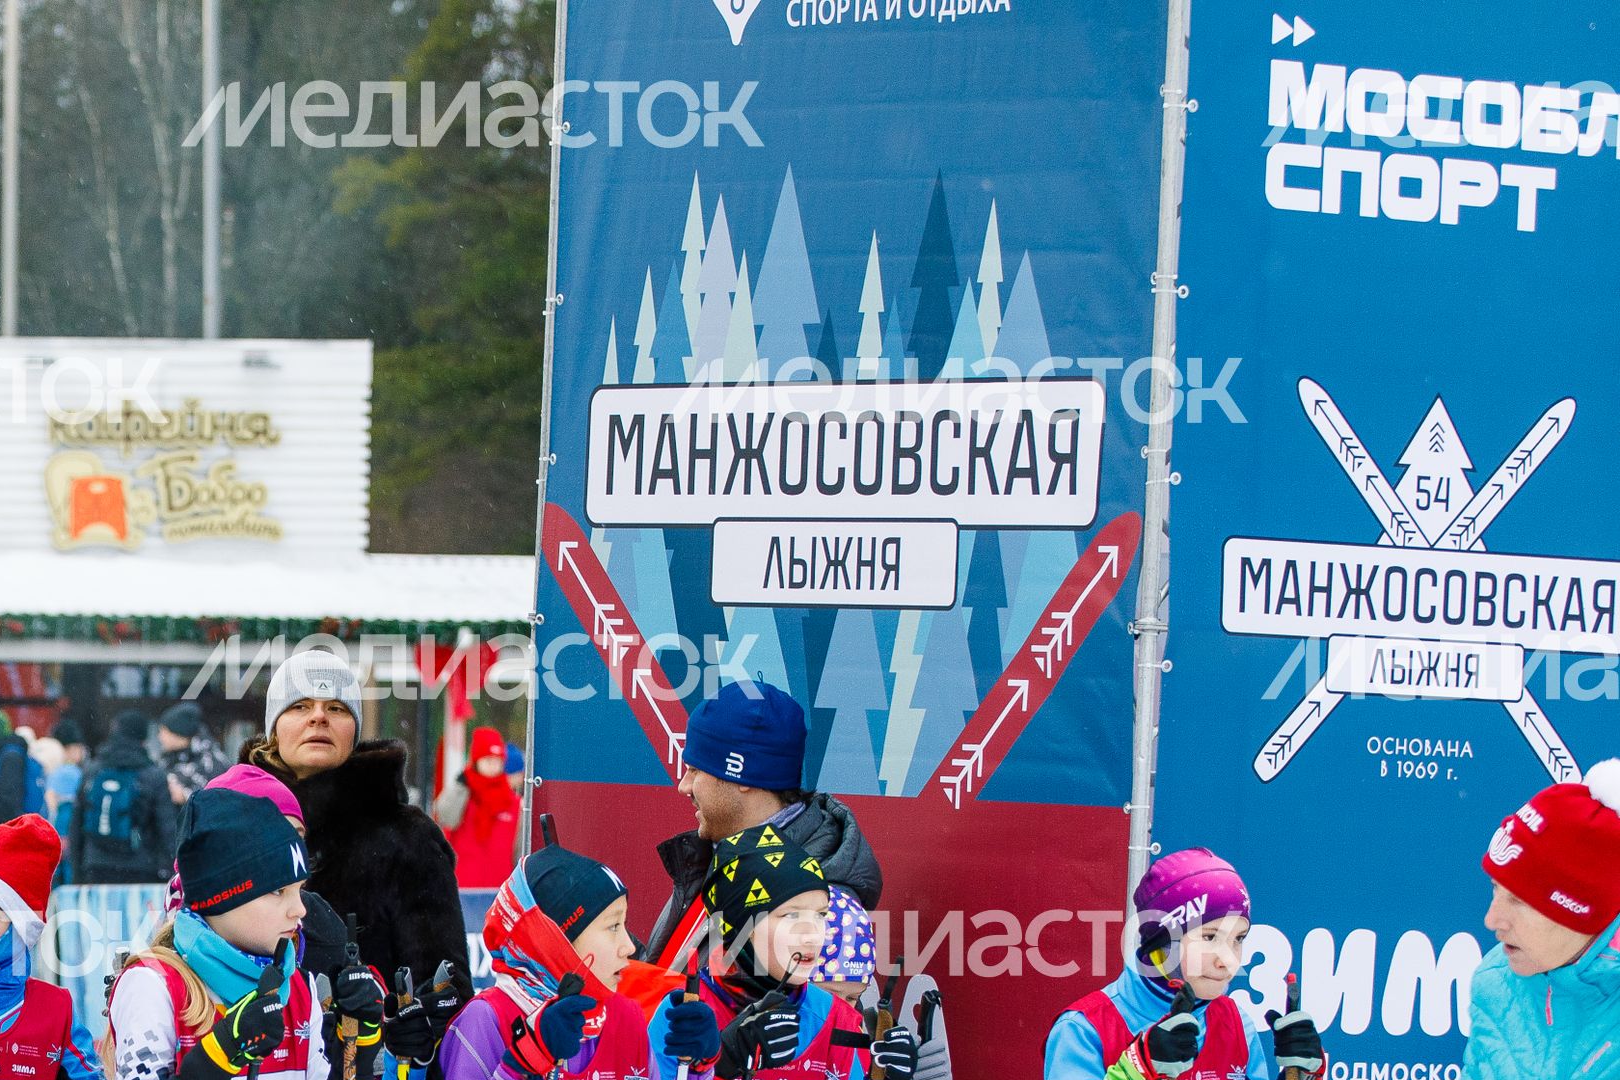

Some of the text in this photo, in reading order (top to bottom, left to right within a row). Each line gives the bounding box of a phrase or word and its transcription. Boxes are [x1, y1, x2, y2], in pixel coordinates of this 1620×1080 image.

[1265, 143, 1556, 232] СПОРТ
[605, 409, 1081, 497] МАНЖОСОВСКАЯ
[1415, 476, 1451, 513] 54
[762, 536, 902, 591] ЛЫЖНЯ
[1239, 556, 1616, 634] МАНЖОСОВСКАЯ
[1370, 648, 1480, 689] ЛЫЖНЯ
[1367, 737, 1474, 759] ОСНОВАНА
[1397, 762, 1439, 779] 1969
[1550, 890, 1584, 914] BOSCO
[843, 961, 865, 969] ONLY
